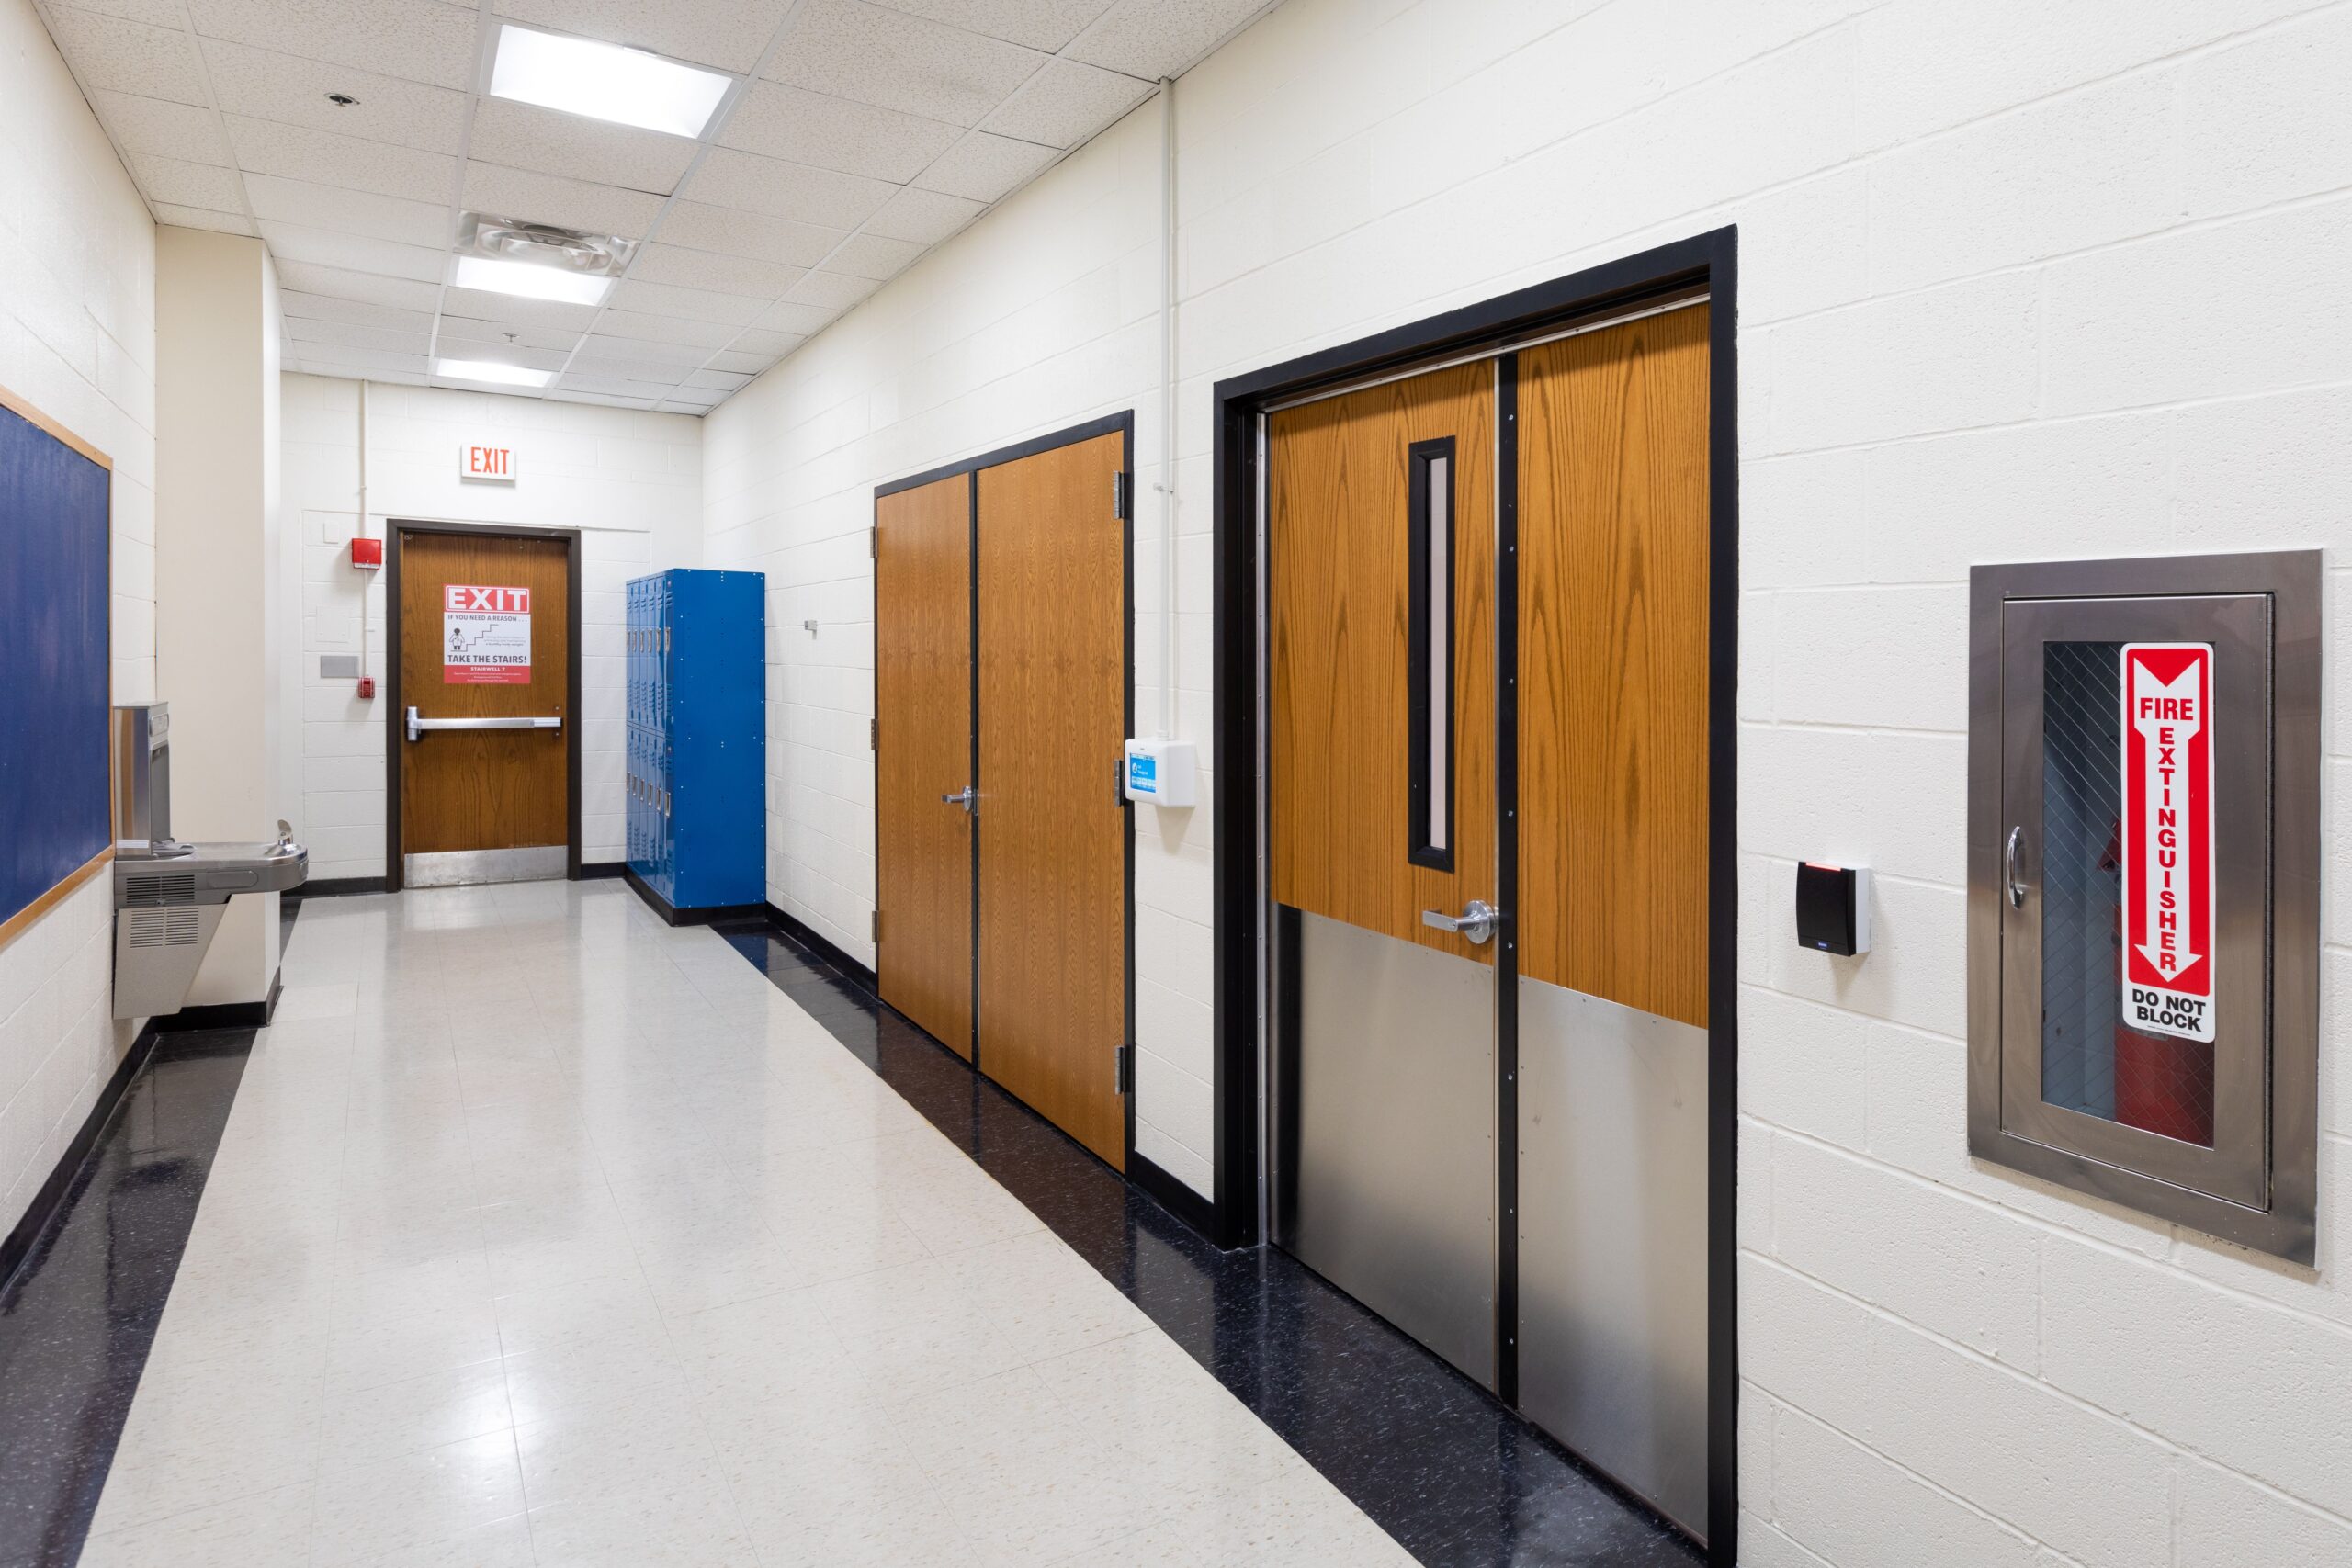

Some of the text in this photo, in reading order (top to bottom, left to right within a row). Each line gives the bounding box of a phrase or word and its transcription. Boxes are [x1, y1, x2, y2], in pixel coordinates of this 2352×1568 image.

[471, 446, 509, 474] EXIT
[448, 587, 527, 611] EXIT
[447, 655, 527, 664] TAKE THE STAIRS!
[2140, 697, 2194, 722] FIRE
[2158, 727, 2177, 972] EXTINGUISHER
[2132, 988, 2206, 1016] DO NOT
[2137, 1005, 2202, 1032] BLOCK
